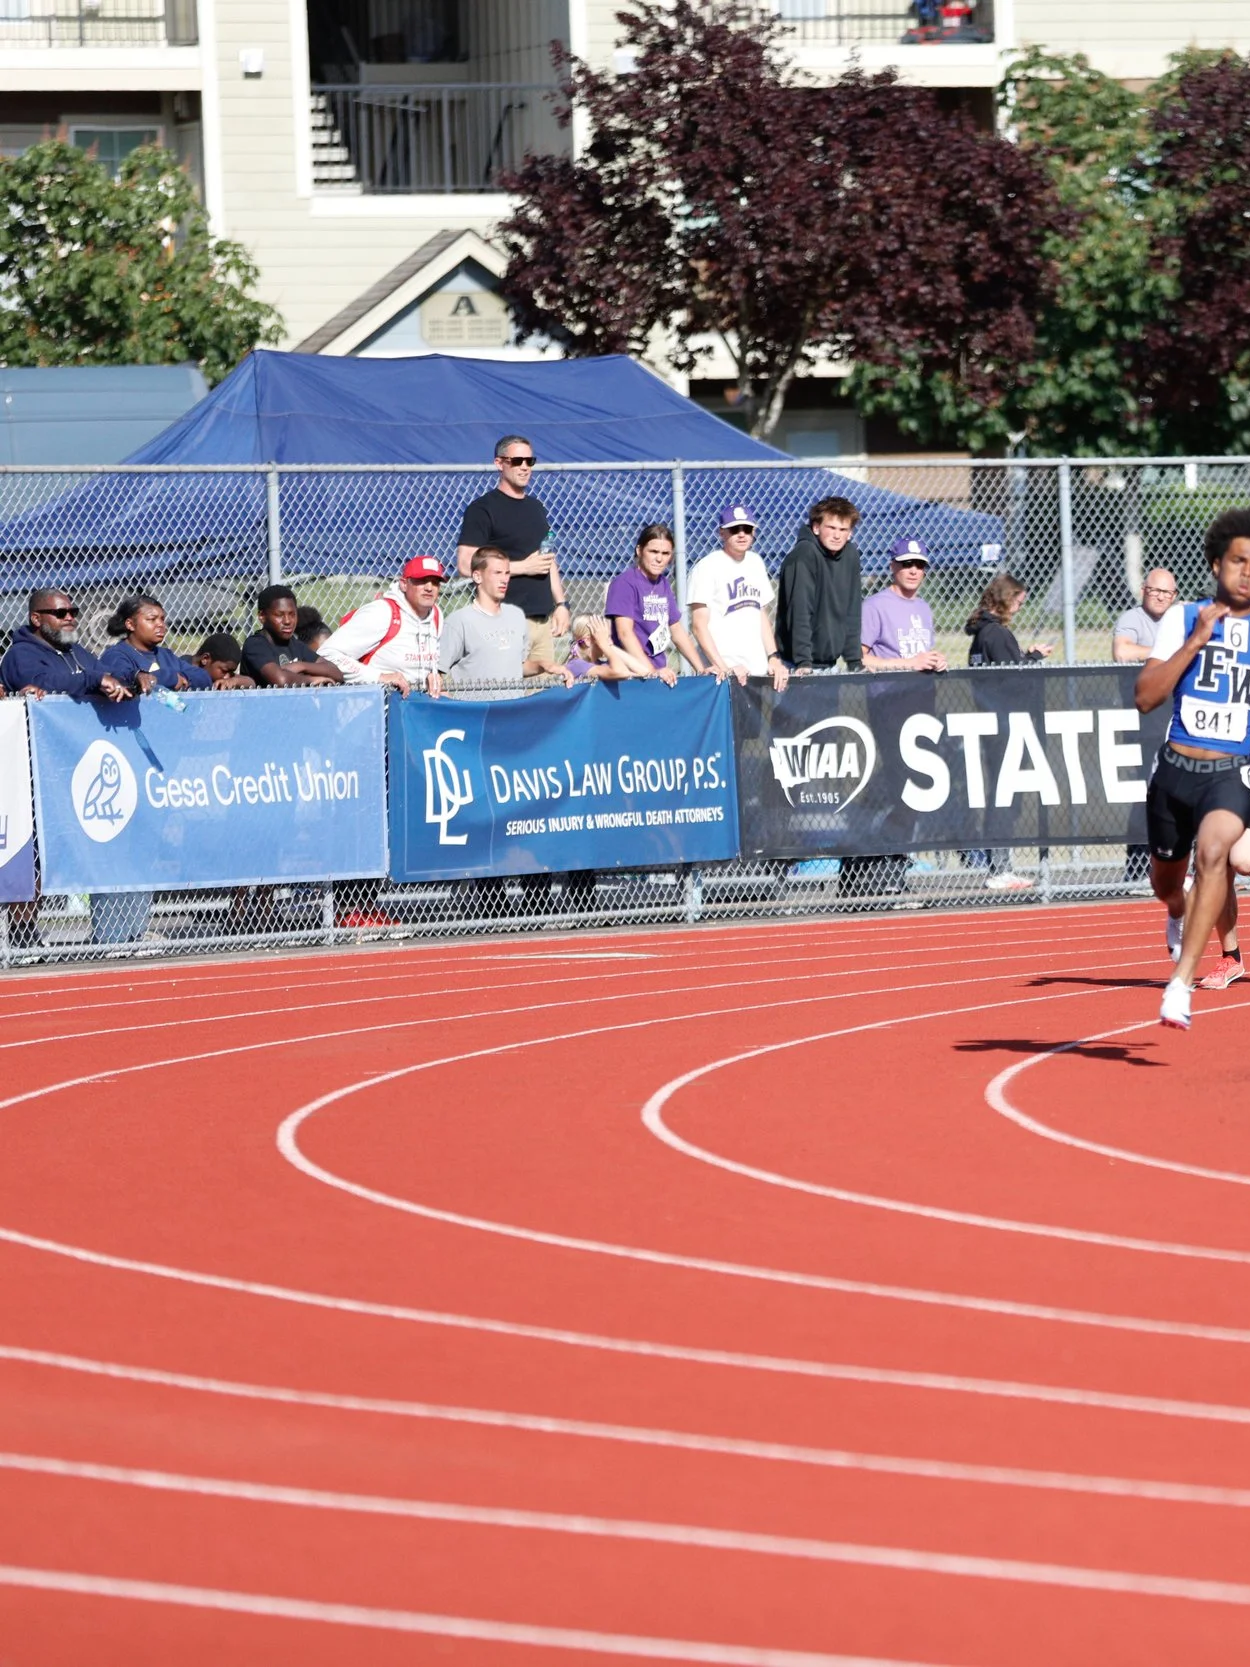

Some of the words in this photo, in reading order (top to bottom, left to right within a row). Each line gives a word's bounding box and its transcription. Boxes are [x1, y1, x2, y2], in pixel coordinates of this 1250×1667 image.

[450, 296, 481, 316] A
[1230, 622, 1242, 648] 6
[1195, 710, 1232, 734] 841
[785, 742, 859, 780] WIAA
[899, 709, 1147, 812] STATE
[145, 767, 207, 809] Gesa
[212, 762, 291, 804] Credit
[297, 759, 359, 801] Union
[490, 765, 562, 803] DAVIS
[564, 759, 613, 797] LAW
[618, 755, 689, 795] GROUP,
[693, 756, 726, 789] P.S.
[506, 816, 546, 836] SERIOUS
[548, 815, 584, 833] INJURY
[586, 816, 594, 829] &
[595, 811, 644, 829] WRONGFUL
[646, 809, 673, 826] DEATH
[675, 806, 724, 824] ATTORNEYS
